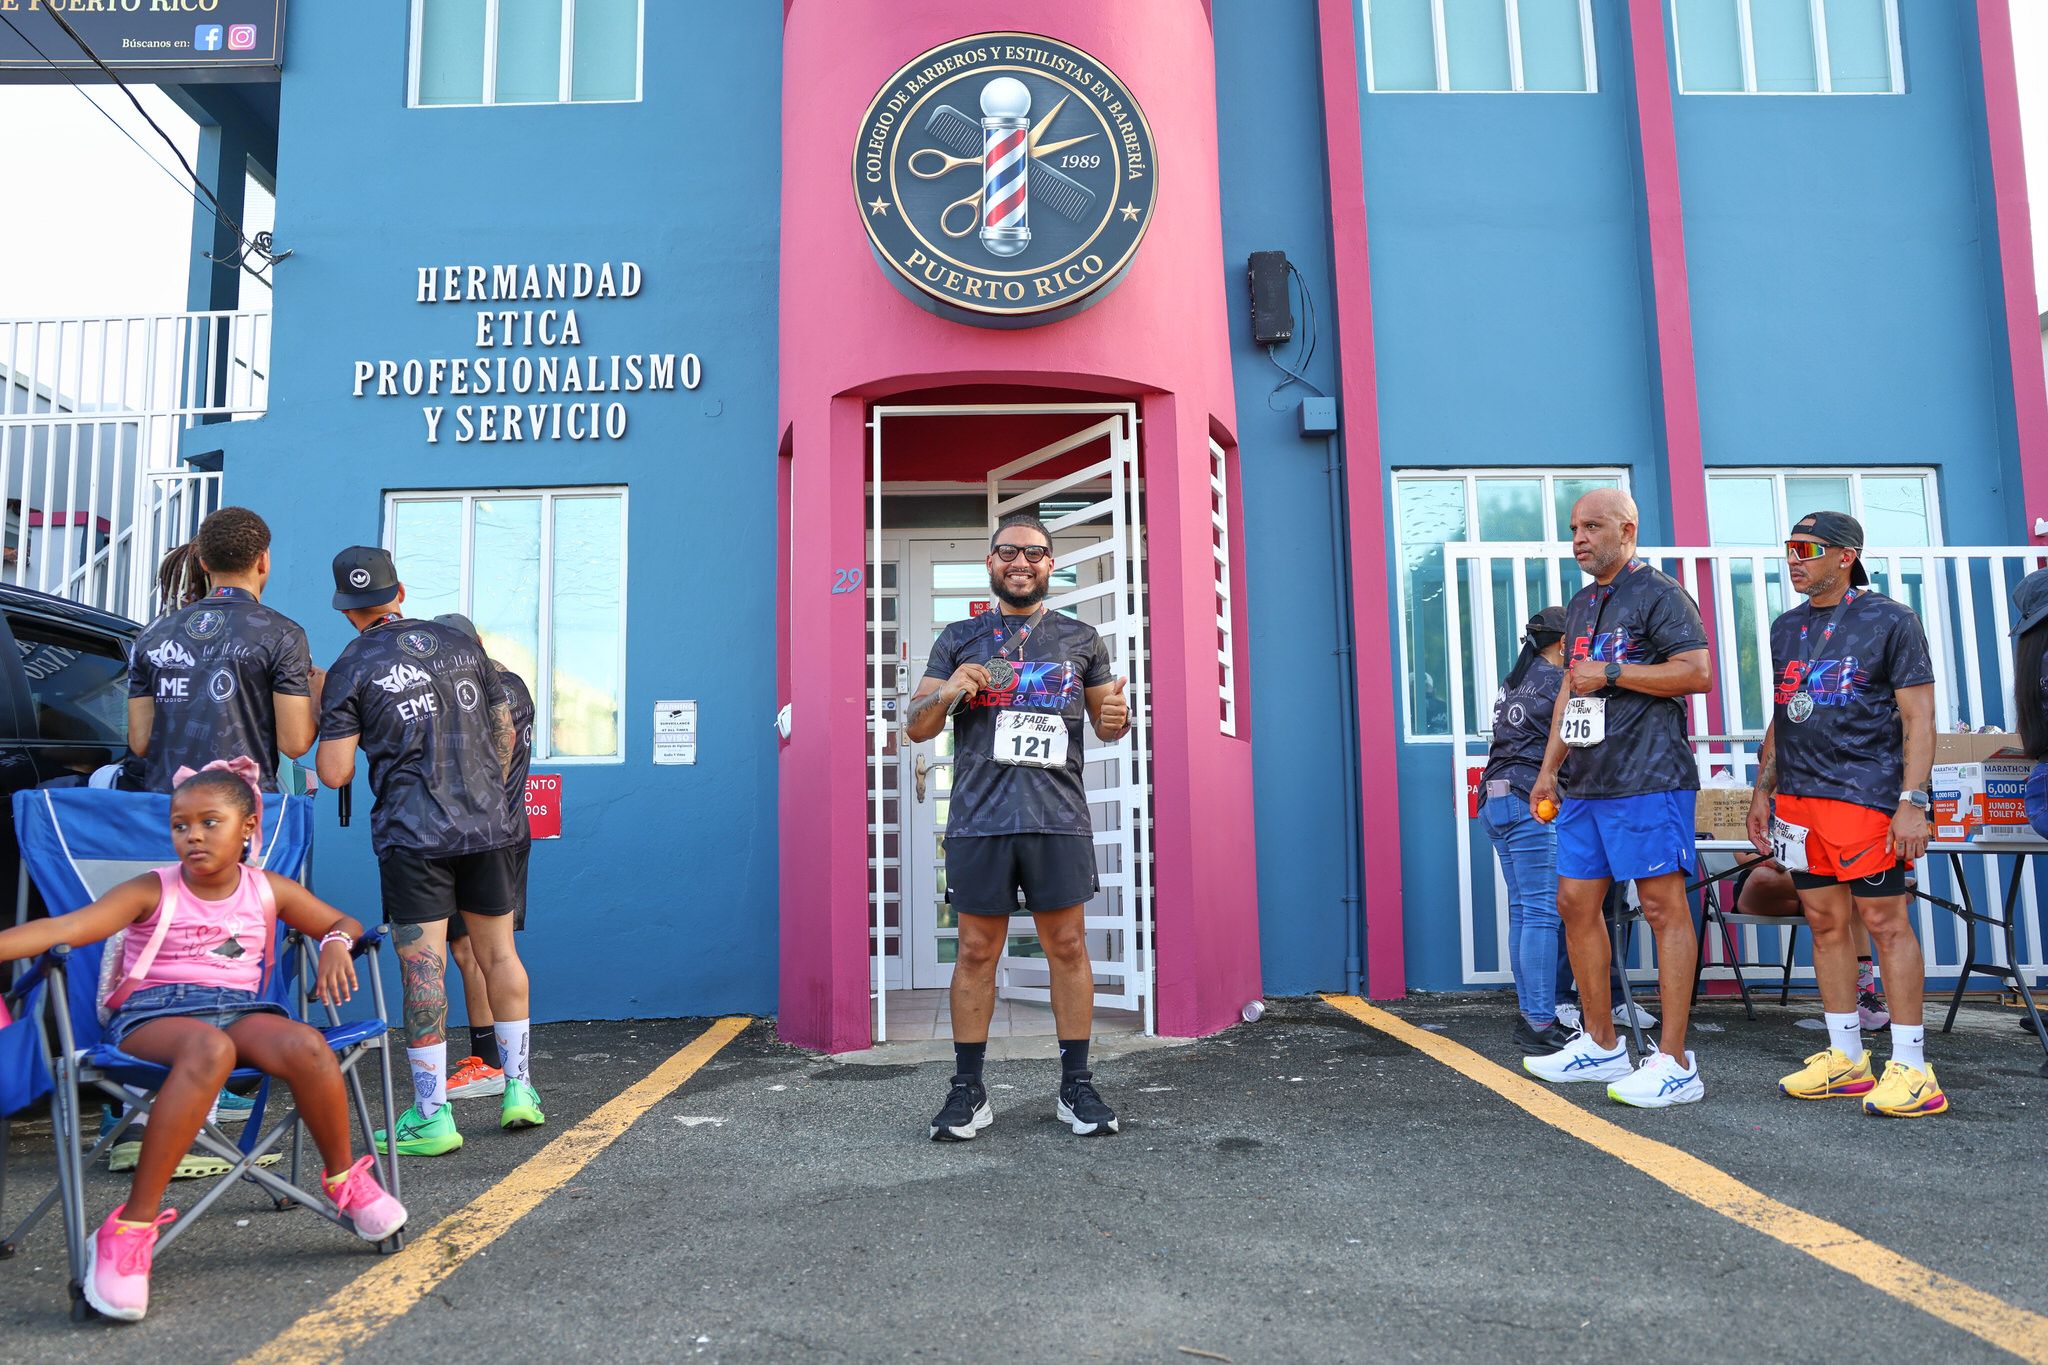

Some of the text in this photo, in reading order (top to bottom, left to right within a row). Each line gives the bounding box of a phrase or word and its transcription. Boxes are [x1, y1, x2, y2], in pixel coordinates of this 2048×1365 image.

[29, 0, 144, 12] PUERTO
[149, 0, 218, 11] RICO
[122, 38, 190, 49] Búscanos en:
[866, 46, 1147, 183] COLEGIO DE BARBEROS Y ESTILISTAS EN BARBERÍA
[1060, 155, 1100, 169] 1989
[416, 262, 642, 302] HERMANDAD
[904, 248, 1104, 300] PUERTO RICO
[476, 309, 582, 347] ETICA
[352, 353, 701, 396] PROFESIONALISMO
[423, 402, 627, 443] Y SERVICIO
[832, 568, 863, 595] 29
[1779, 660, 1840, 692] 5K
[156, 677, 190, 697] ME
[396, 693, 438, 720] EME
[970, 694, 1014, 710] FADE
[1013, 694, 1025, 706] &
[1021, 715, 1050, 725] FADE
[1035, 724, 1056, 733] RUN
[1565, 720, 1591, 739] 216
[1011, 735, 1051, 759] 121
[1984, 765, 2030, 773] MARATHON
[1988, 783, 2017, 795] 6,000
[1988, 802, 2016, 810] JUMBO
[1989, 810, 2027, 818] TOILET PA
[1781, 831, 1795, 841] RUN
